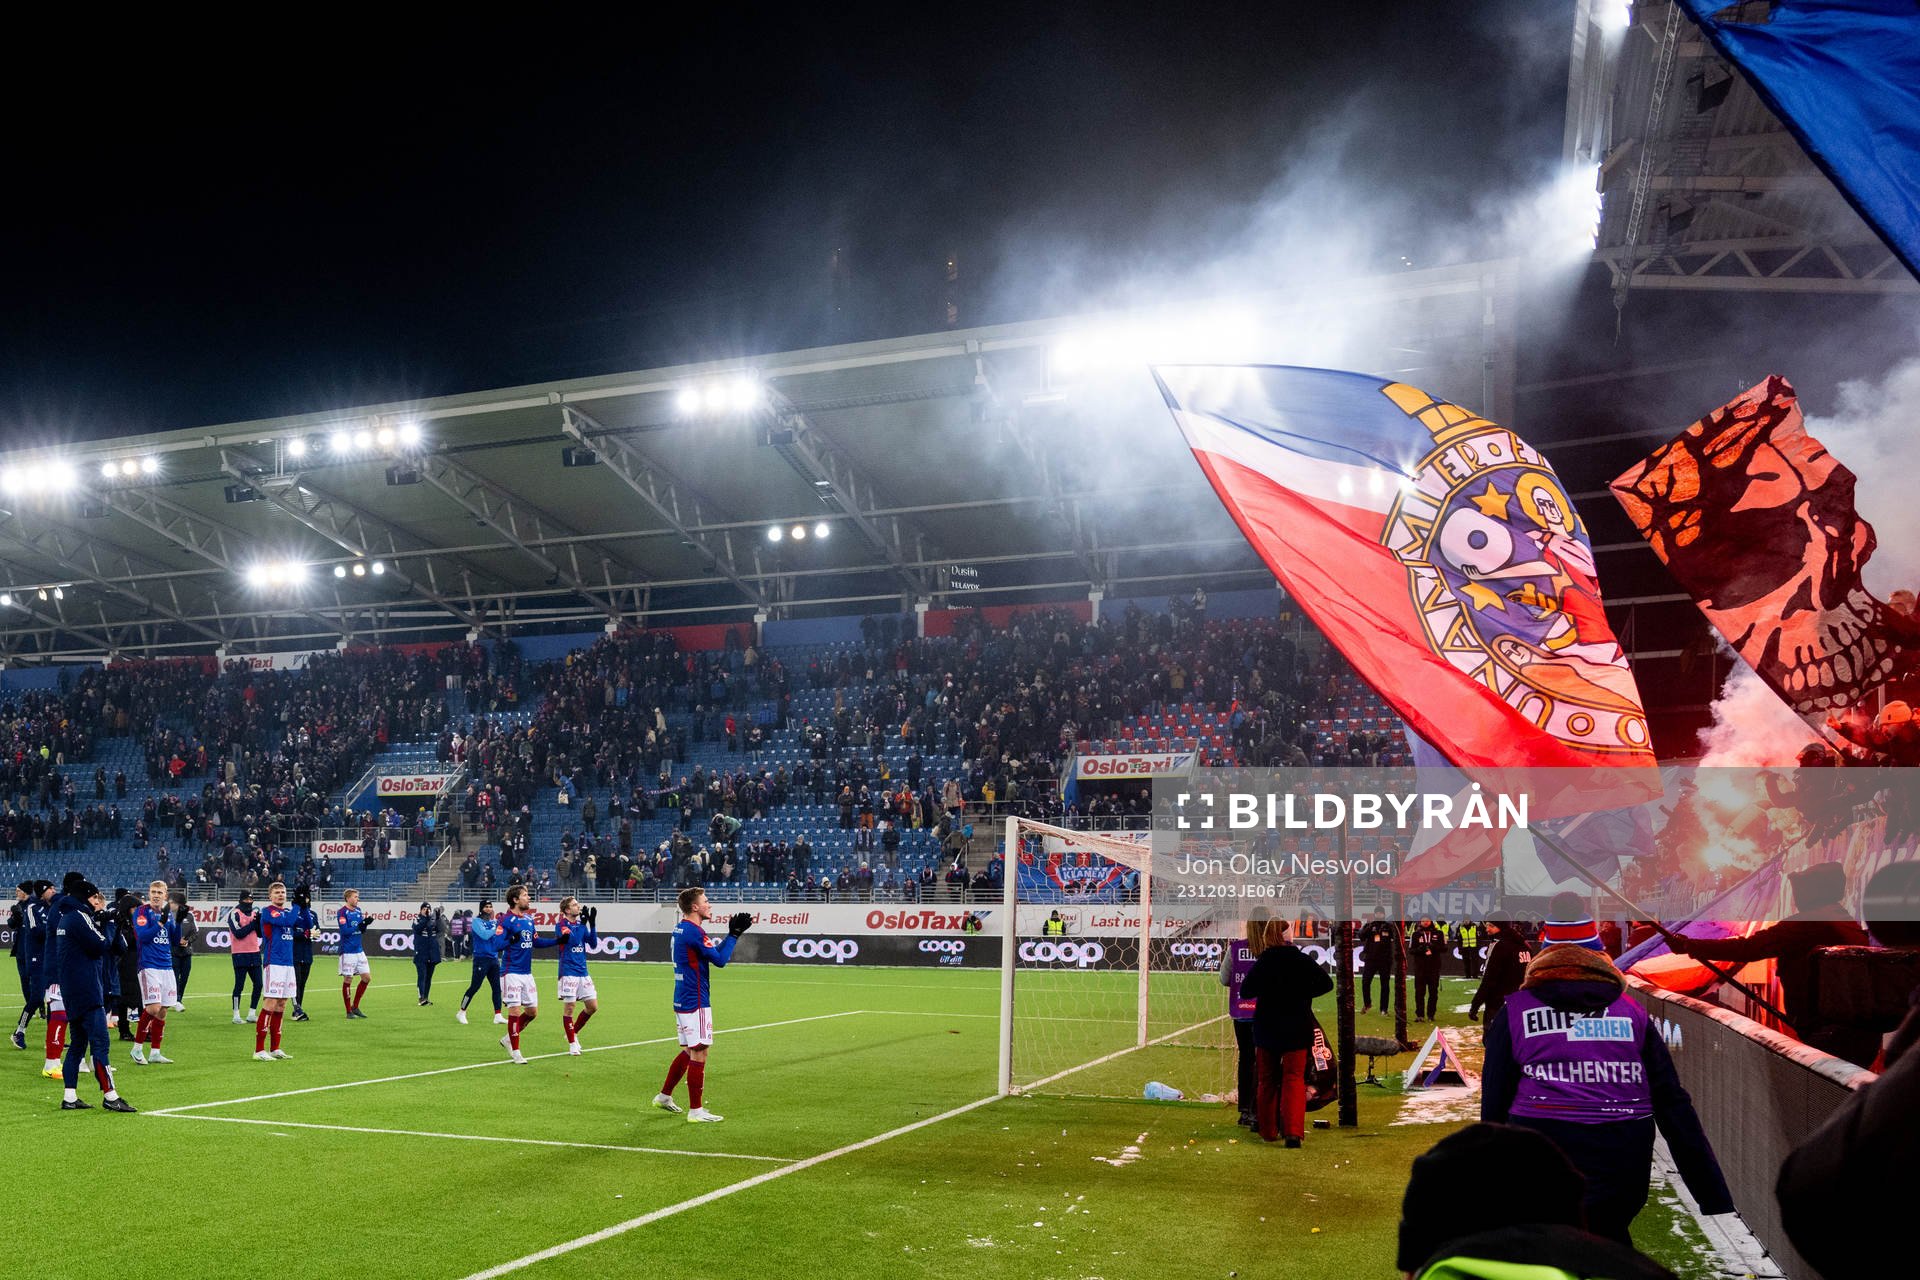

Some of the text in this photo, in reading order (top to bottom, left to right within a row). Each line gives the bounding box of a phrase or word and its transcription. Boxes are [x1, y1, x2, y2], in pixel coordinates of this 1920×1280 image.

[1083, 757, 1171, 775] OsloTaxi
[381, 777, 444, 792] OsloTaxi
[1063, 868, 1106, 881] KLANEN
[770, 913, 809, 925] Bestill
[866, 910, 970, 930] OsloTaxi
[1091, 915, 1120, 928] Last
[782, 938, 859, 963] coop
[918, 940, 965, 954] coop
[1018, 941, 1104, 968] coop
[1170, 942, 1222, 958] coop
[1527, 1009, 1577, 1034] ELITE
[1574, 1019, 1631, 1039] SERIEN
[1524, 1060, 1643, 1084] BALLHENTER
